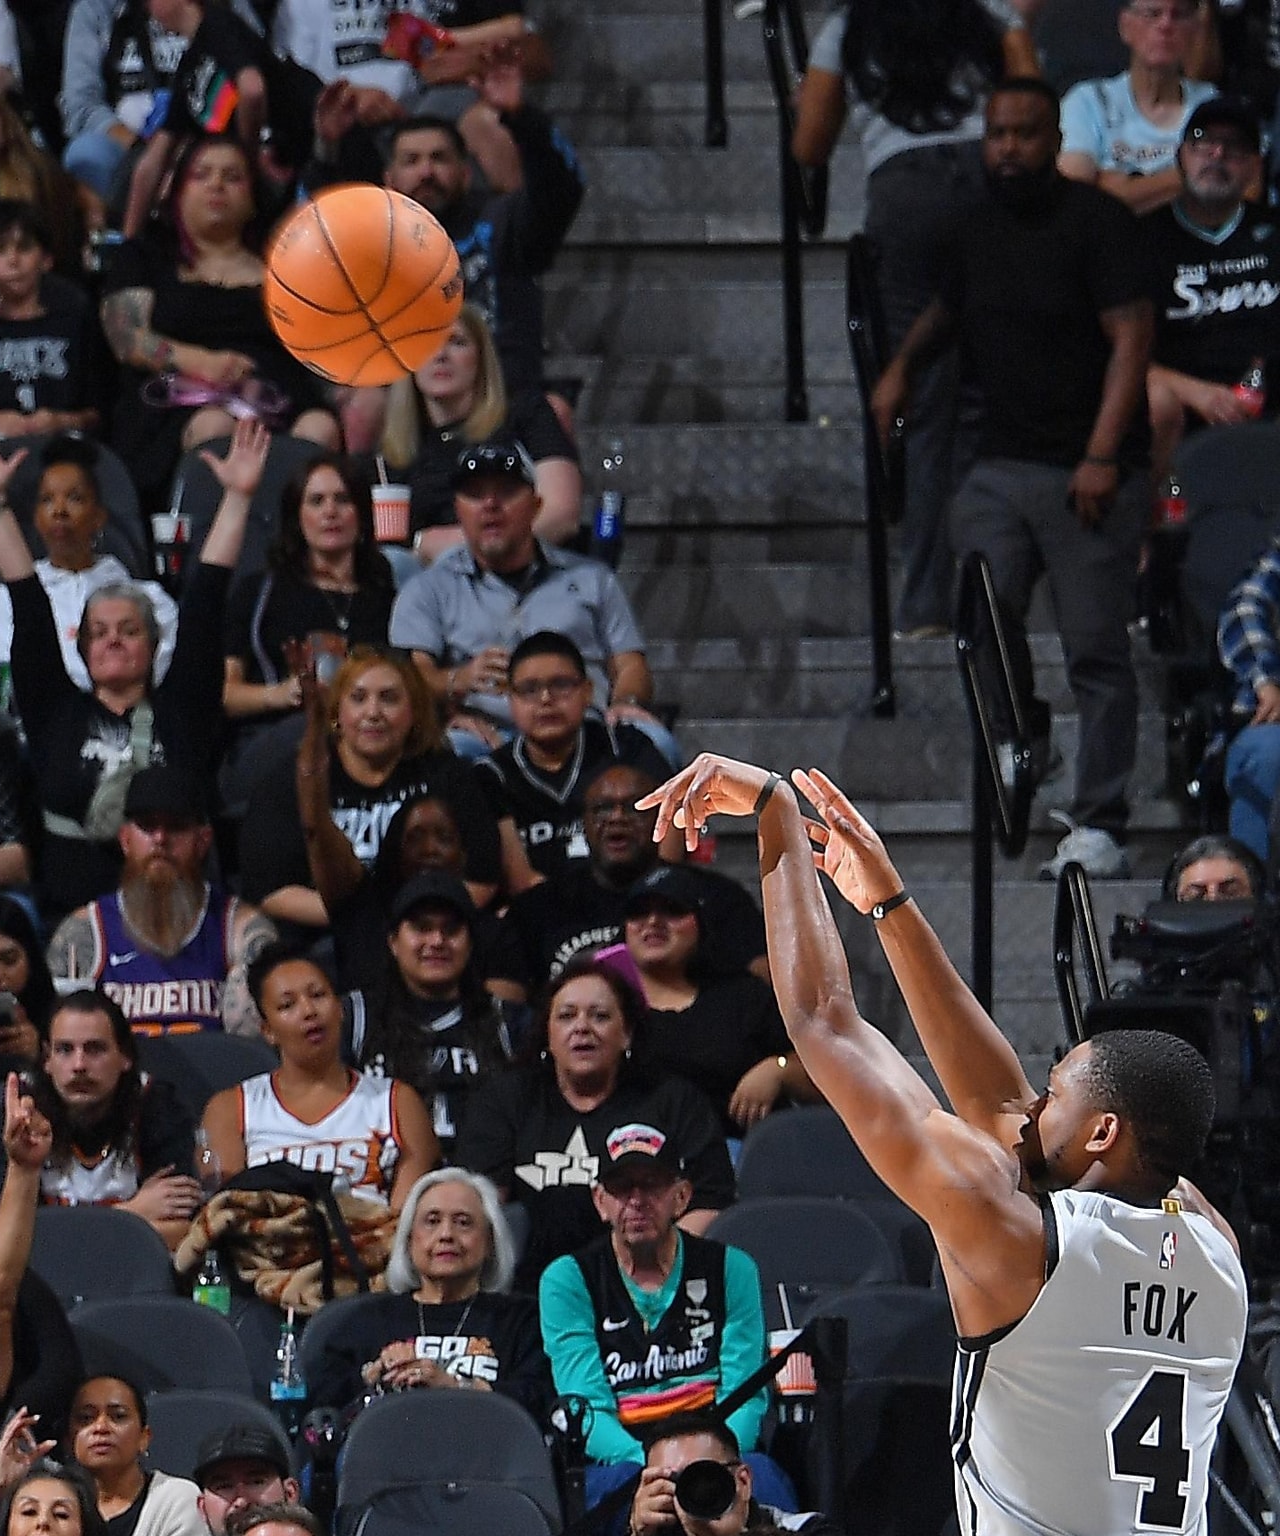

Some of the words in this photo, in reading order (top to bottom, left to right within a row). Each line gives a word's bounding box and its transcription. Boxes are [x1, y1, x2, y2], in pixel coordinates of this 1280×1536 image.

[1123, 1281, 1198, 1345] FOX
[415, 1335, 469, 1360] GO
[606, 1351, 643, 1388] San
[644, 1344, 709, 1381] Antonio
[1105, 1365, 1193, 1534] 4
